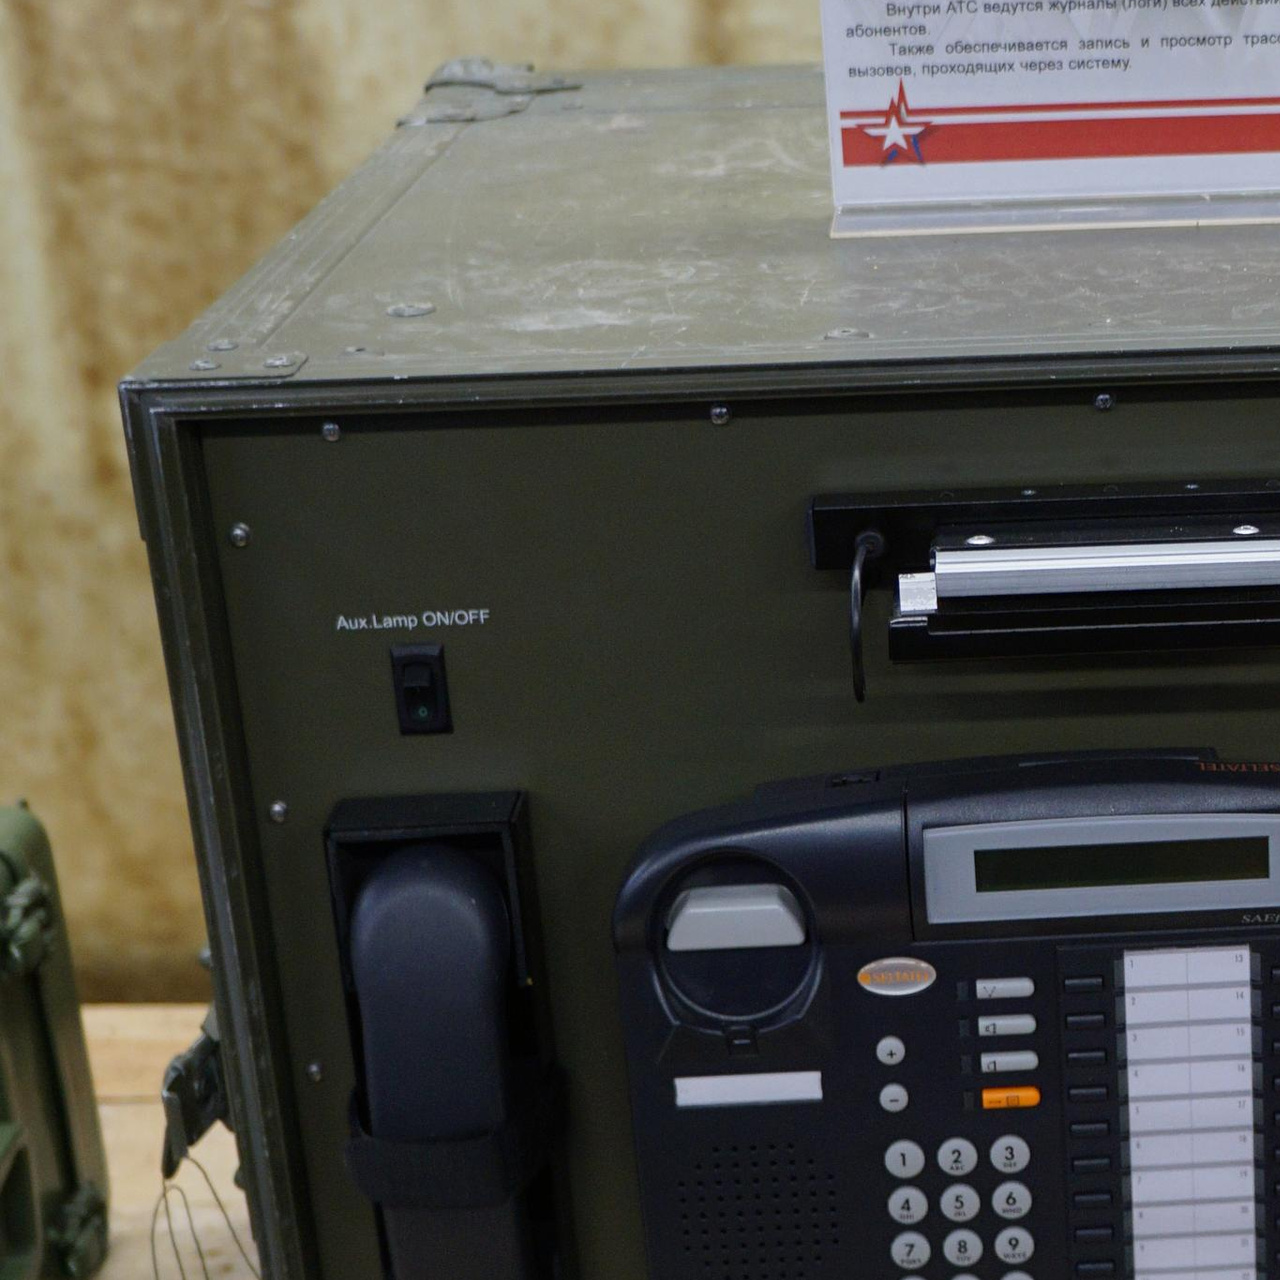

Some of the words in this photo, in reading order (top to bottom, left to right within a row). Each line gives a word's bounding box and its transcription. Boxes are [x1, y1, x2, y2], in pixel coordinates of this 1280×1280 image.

[886, 1, 941, 17] Внутри
[983, 0, 1044, 15] ведутся
[846, 23, 930, 36] абонентов.
[889, 41, 935, 54] Также
[945, 38, 1068, 53] обеспечивается
[1079, 38, 1131, 49] запись
[1141, 38, 1150, 48] и
[1161, 36, 1233, 50] просмотр
[848, 64, 916, 79] вызовов,
[921, 62, 1015, 77] проходящих
[1019, 60, 1063, 74] через
[1068, 59, 1132, 73] систему.
[336, 613, 418, 631] Aux.Lamp
[422, 609, 490, 627] ON/OFF
[900, 1153, 906, 1167] 1
[951, 1149, 962, 1164] 2
[1004, 1146, 1015, 1161] 3
[901, 1198, 911, 1212] 4
[954, 1195, 964, 1210] 5
[1006, 1191, 1017, 1206] 6
[905, 1243, 915, 1257] 7
[957, 1240, 968, 1254] 8
[1009, 1237, 1019, 1251] 9
